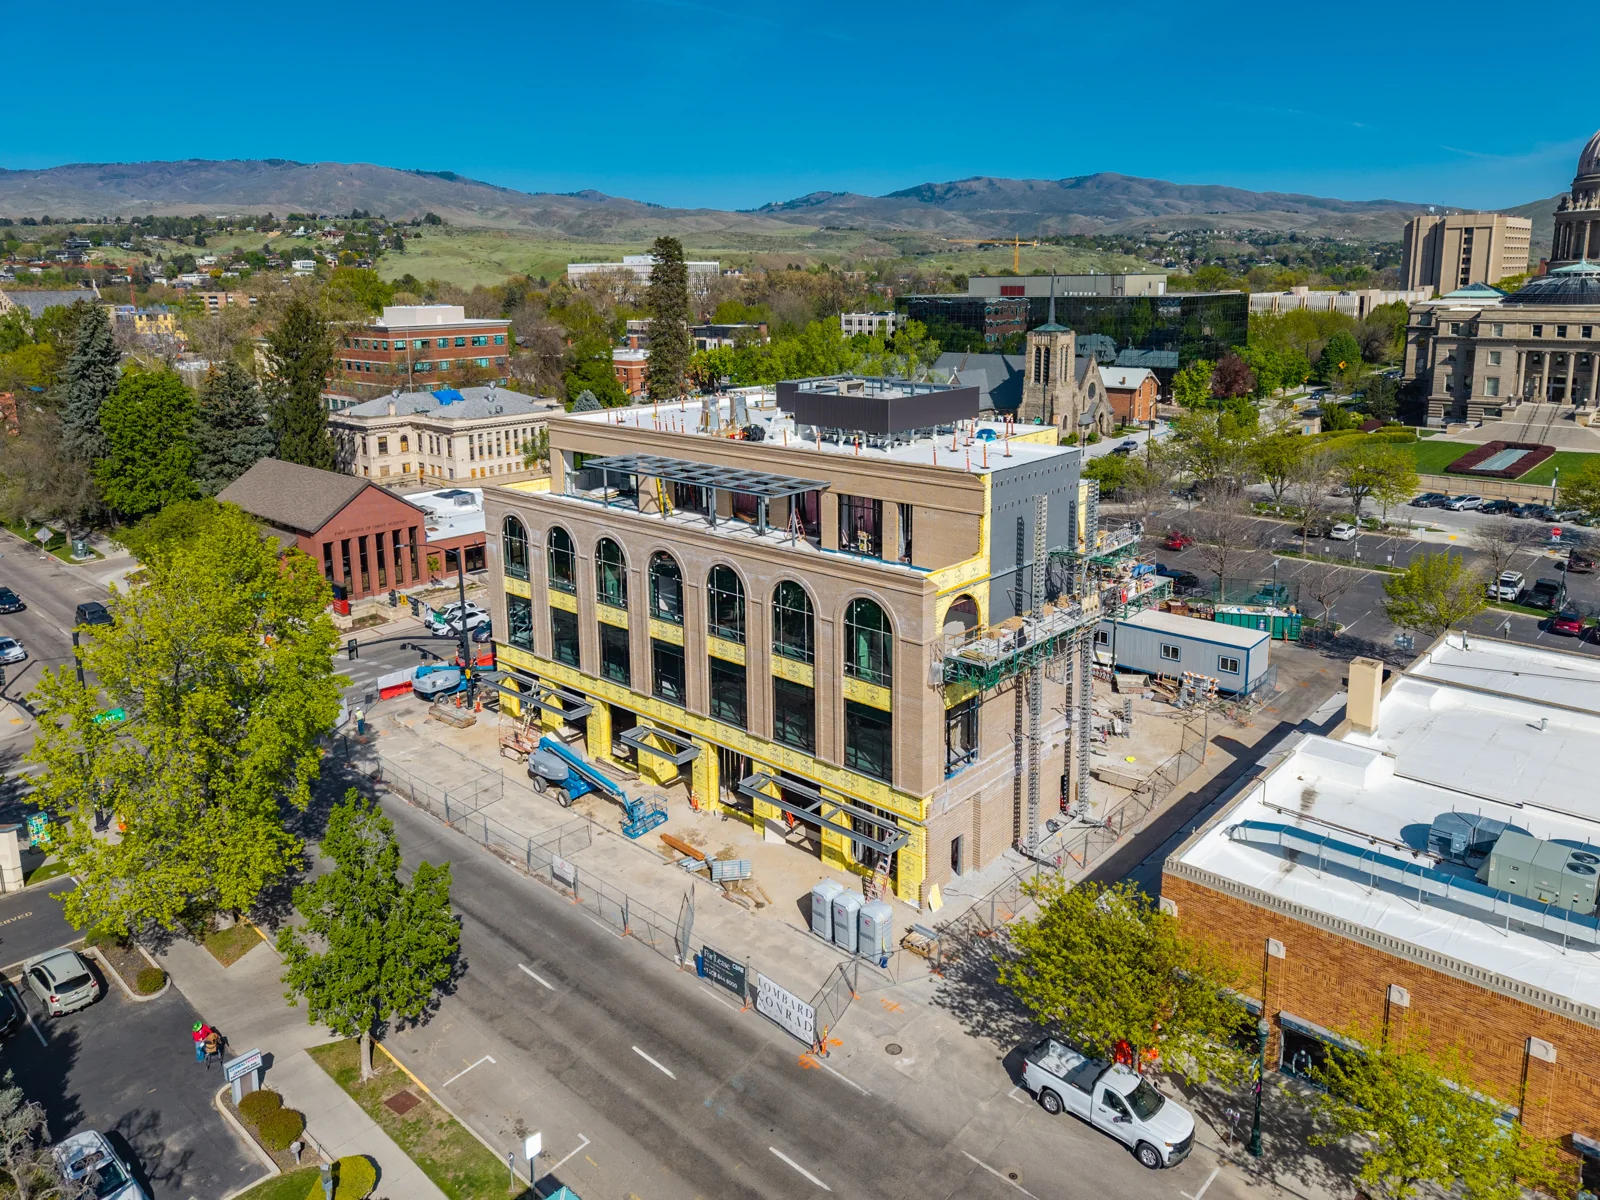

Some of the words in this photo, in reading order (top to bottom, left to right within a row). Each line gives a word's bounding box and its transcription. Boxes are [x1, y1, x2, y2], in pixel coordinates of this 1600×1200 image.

[713, 953, 730, 970] Lease
[757, 990, 813, 1032] CONRAD
[758, 977, 813, 1019] LOMBARD
